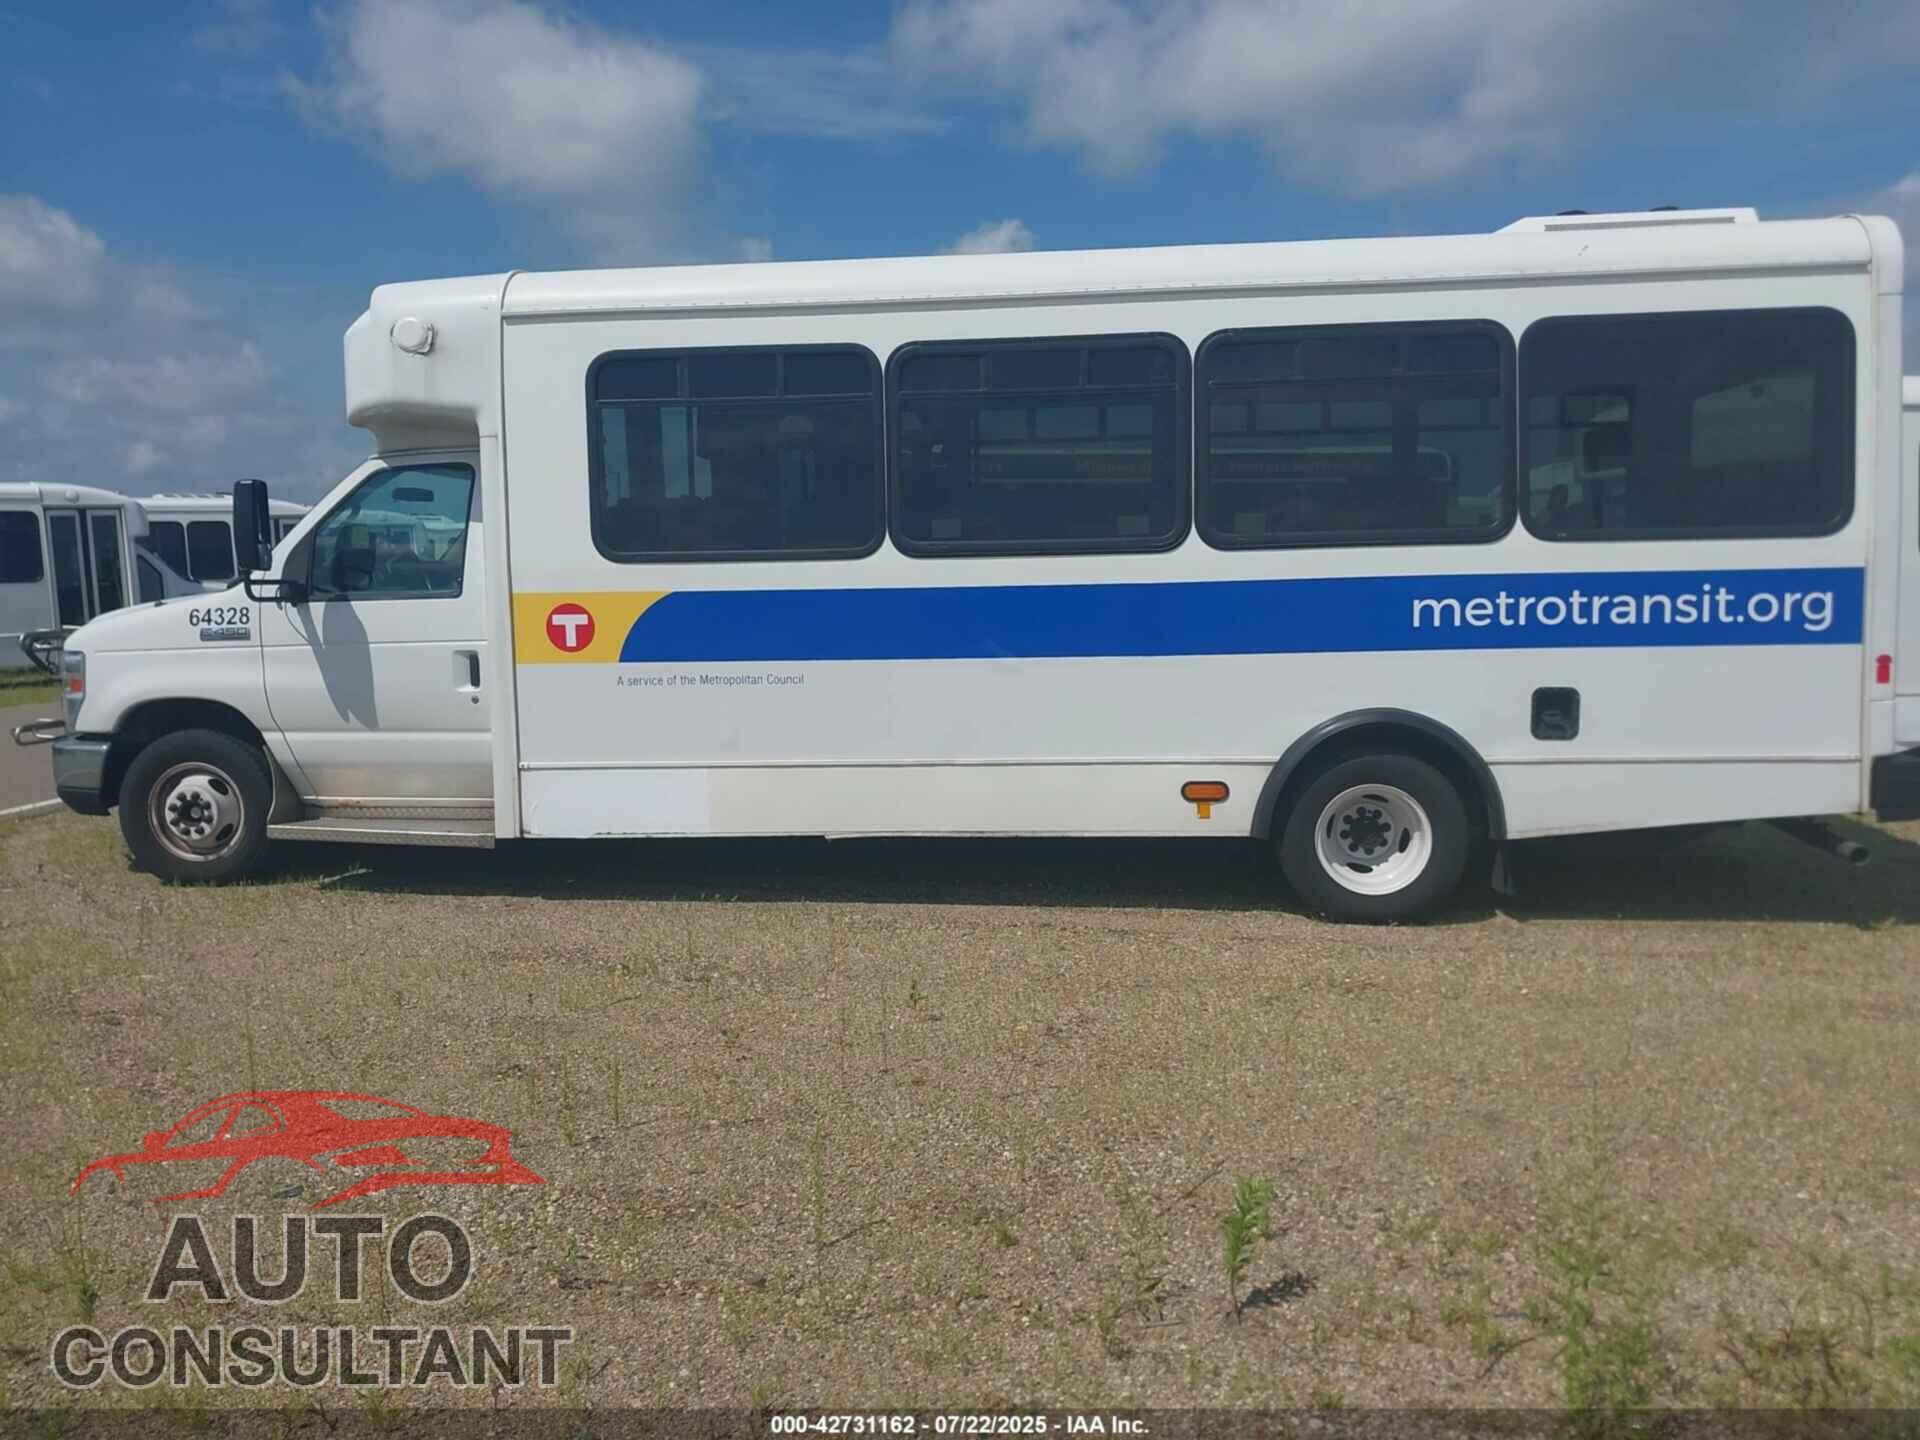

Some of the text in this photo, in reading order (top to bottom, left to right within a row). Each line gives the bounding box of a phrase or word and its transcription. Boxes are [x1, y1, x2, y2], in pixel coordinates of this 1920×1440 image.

[189, 606, 250, 627] 64328
[1412, 582, 1836, 632] metrotransit.org
[551, 614, 589, 647] T
[616, 673, 805, 687] A service of the Metropolitan Council
